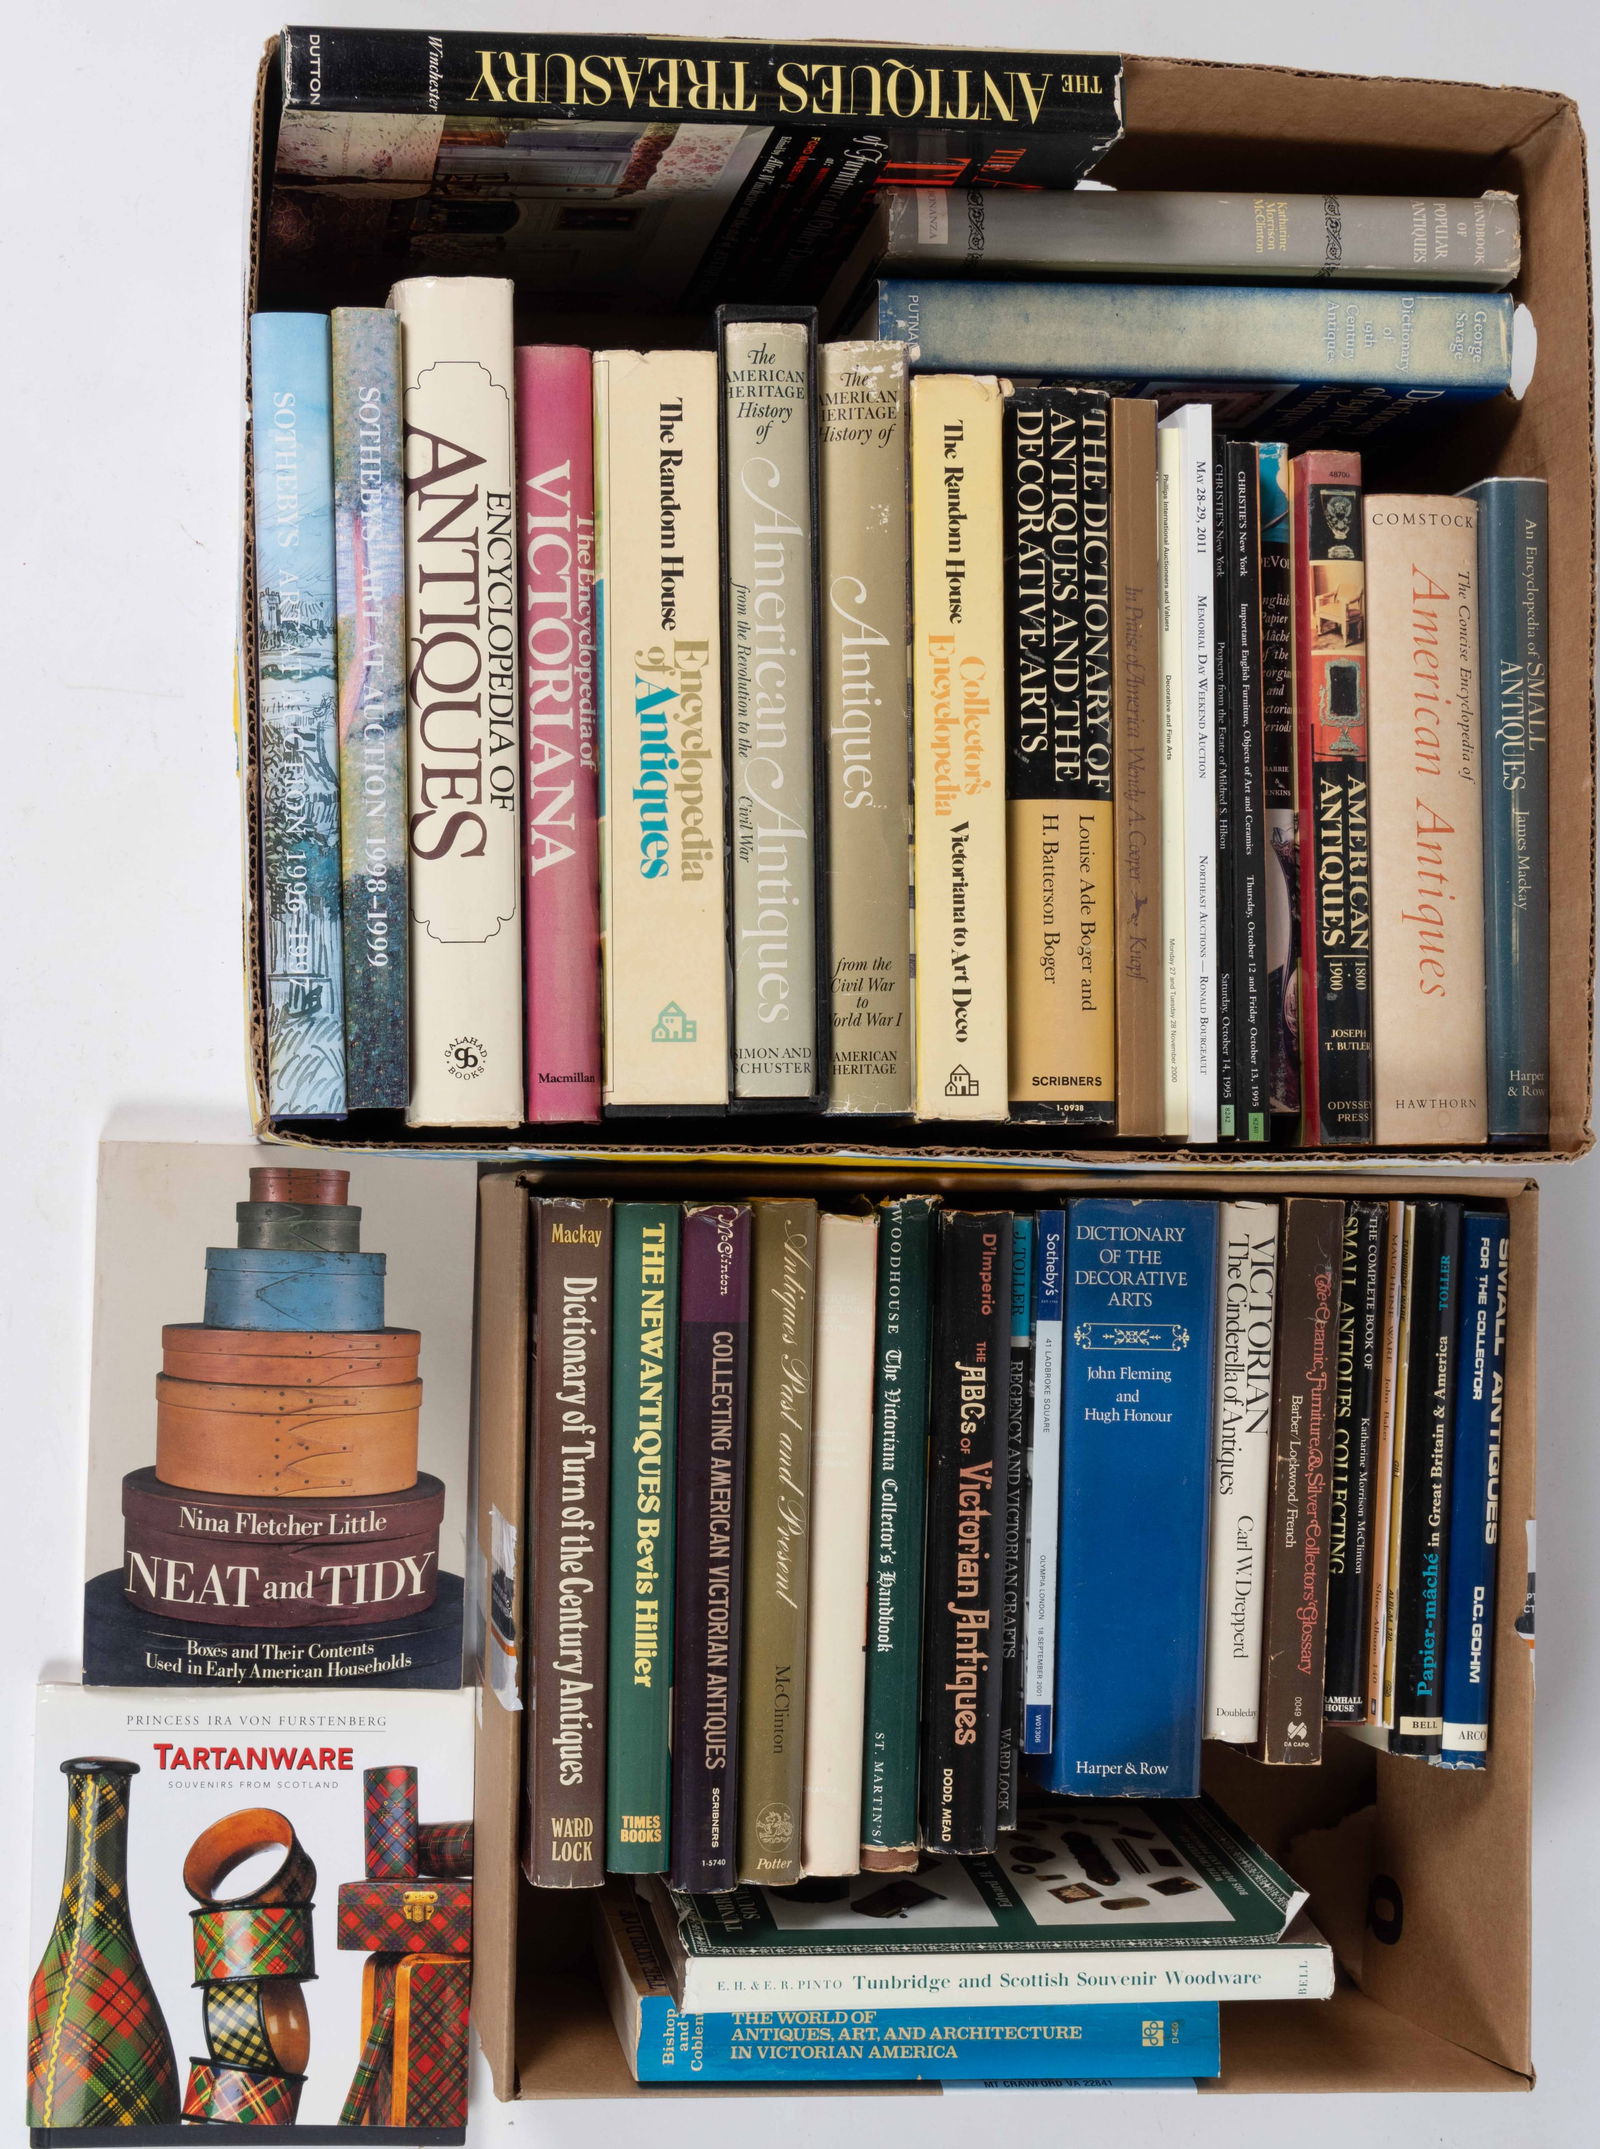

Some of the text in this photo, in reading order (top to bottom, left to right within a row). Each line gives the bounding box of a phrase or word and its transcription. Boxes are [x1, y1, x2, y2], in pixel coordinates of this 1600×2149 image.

[308, 34, 321, 106] DUTTON
[427, 34, 443, 113] Winchester
[466, 50, 1103, 125] THE ANTIQUES TREASURY
[1323, 300, 1340, 363] Antiques
[1341, 304, 1360, 362] Century
[1363, 320, 1376, 348] 19th
[1382, 327, 1396, 341] of
[1396, 297, 1415, 374] Dictionary
[1450, 312, 1469, 361] Savage
[1468, 311, 1487, 364] George
[660, 397, 684, 632] The Random House
[1196, 488, 1206, 523] 28-29,
[1372, 513, 1474, 529] COMSTOCK
[1197, 529, 1206, 553] 2011
[361, 563, 386, 625] ART
[1016, 409, 1048, 753] DECORATIVE ARTS
[1047, 408, 1081, 782] ANTIQUES AND THE
[1082, 409, 1111, 793] THE DICTIONARY OF
[362, 637, 385, 676] AT
[404, 419, 487, 861] ANTIQUES
[486, 491, 515, 813] ENCYCLOPEDIA OF
[526, 459, 577, 877] VICTORIANA
[573, 514, 597, 771] The Encyclopedia of
[830, 576, 890, 809] Antiques
[1527, 663, 1547, 752] SMALL
[363, 685, 388, 820] AUCTION
[740, 457, 808, 1023] American Antiques
[928, 633, 961, 817] Encyclopedia
[959, 656, 991, 796] Collector's
[1496, 659, 1526, 792] ANTIQUES
[633, 645, 681, 880] of Antiques
[673, 638, 714, 883] Encyclopedia
[1401, 563, 1456, 998] American Antiques
[1319, 778, 1345, 947] ANTIQUES
[1347, 775, 1370, 951] AMERICAN
[366, 836, 389, 968] 1998-1999
[949, 821, 972, 1043] Victoriana to Art Deco
[1221, 973, 1230, 1014] Saturday,
[444, 1036, 488, 1059] GALAHAD
[832, 1051, 897, 1062] AMERICAN
[1222, 1016, 1230, 1055] October
[1331, 1029, 1367, 1038] JOSEPH
[448, 1065, 485, 1081] BOOKS
[538, 1072, 595, 1084] Macmillan
[832, 1064, 897, 1075] HERITAGE
[1032, 1076, 1102, 1087] SCRIBNERS
[1223, 1079, 1231, 1098] 1995
[1056, 1104, 1084, 1112] 1-0938
[1395, 1099, 1477, 1109] HAWTHORN
[551, 1223, 602, 1247] Mackay
[1076, 1225, 1186, 1243] DICTIONARY
[1099, 1249, 1162, 1265] OF THE
[979, 1233, 997, 1316] D'Imperio
[1042, 1233, 1060, 1296] Sotheby's
[1075, 1270, 1188, 1287] DECORATIVE
[1439, 1255, 1451, 1311] TOLLER
[1107, 1292, 1153, 1308] ARTS
[1472, 1237, 1490, 1401] FOR THE COLLECTOR
[975, 1341, 987, 1363] THE
[1245, 1236, 1276, 1436] VICTORIAN
[1087, 1366, 1172, 1382] John Fleming
[1116, 1389, 1140, 1403] and
[1084, 1407, 1173, 1423] Hugh Honour
[632, 1222, 666, 1688] THE NEW ANTIQUES Bevis Hillier
[960, 1438, 971, 1454] OF
[179, 1506, 388, 1537] Nina Fletcher Little
[876, 1349, 902, 1653] The Victoriana Collector's Handbook
[552, 1276, 598, 1786] Dictionary of Turn of the Century Antiques
[702, 1331, 734, 1770] COLLECTING AMERICAN VICTORIAN ANTIQUES
[124, 1550, 435, 1608] NEAT and TIDY
[187, 1640, 375, 1660] Boxes and Their Contents
[1416, 1553, 1440, 1696] Papier-mâché
[945, 1601, 990, 1746] Antiques
[127, 1715, 388, 1727] PRINCESS IRA VON FURSTENBERG
[1412, 1721, 1438, 1730] BELL
[153, 1743, 354, 1771] TARTANWARE
[1075, 1761, 1169, 1777] Harper & Row
[551, 1817, 594, 1838] WARD
[621, 1815, 661, 1829] TIMES
[711, 1787, 720, 1848] SCRIBNERS
[942, 1768, 953, 1842] DODD, MEAD
[551, 1841, 593, 1862] LOCK
[620, 1829, 662, 1843] BOOKS
[756, 1857, 793, 1871] Potter
[852, 1970, 1262, 1993] Tunbridge and Scottish Souvenir Woodware
